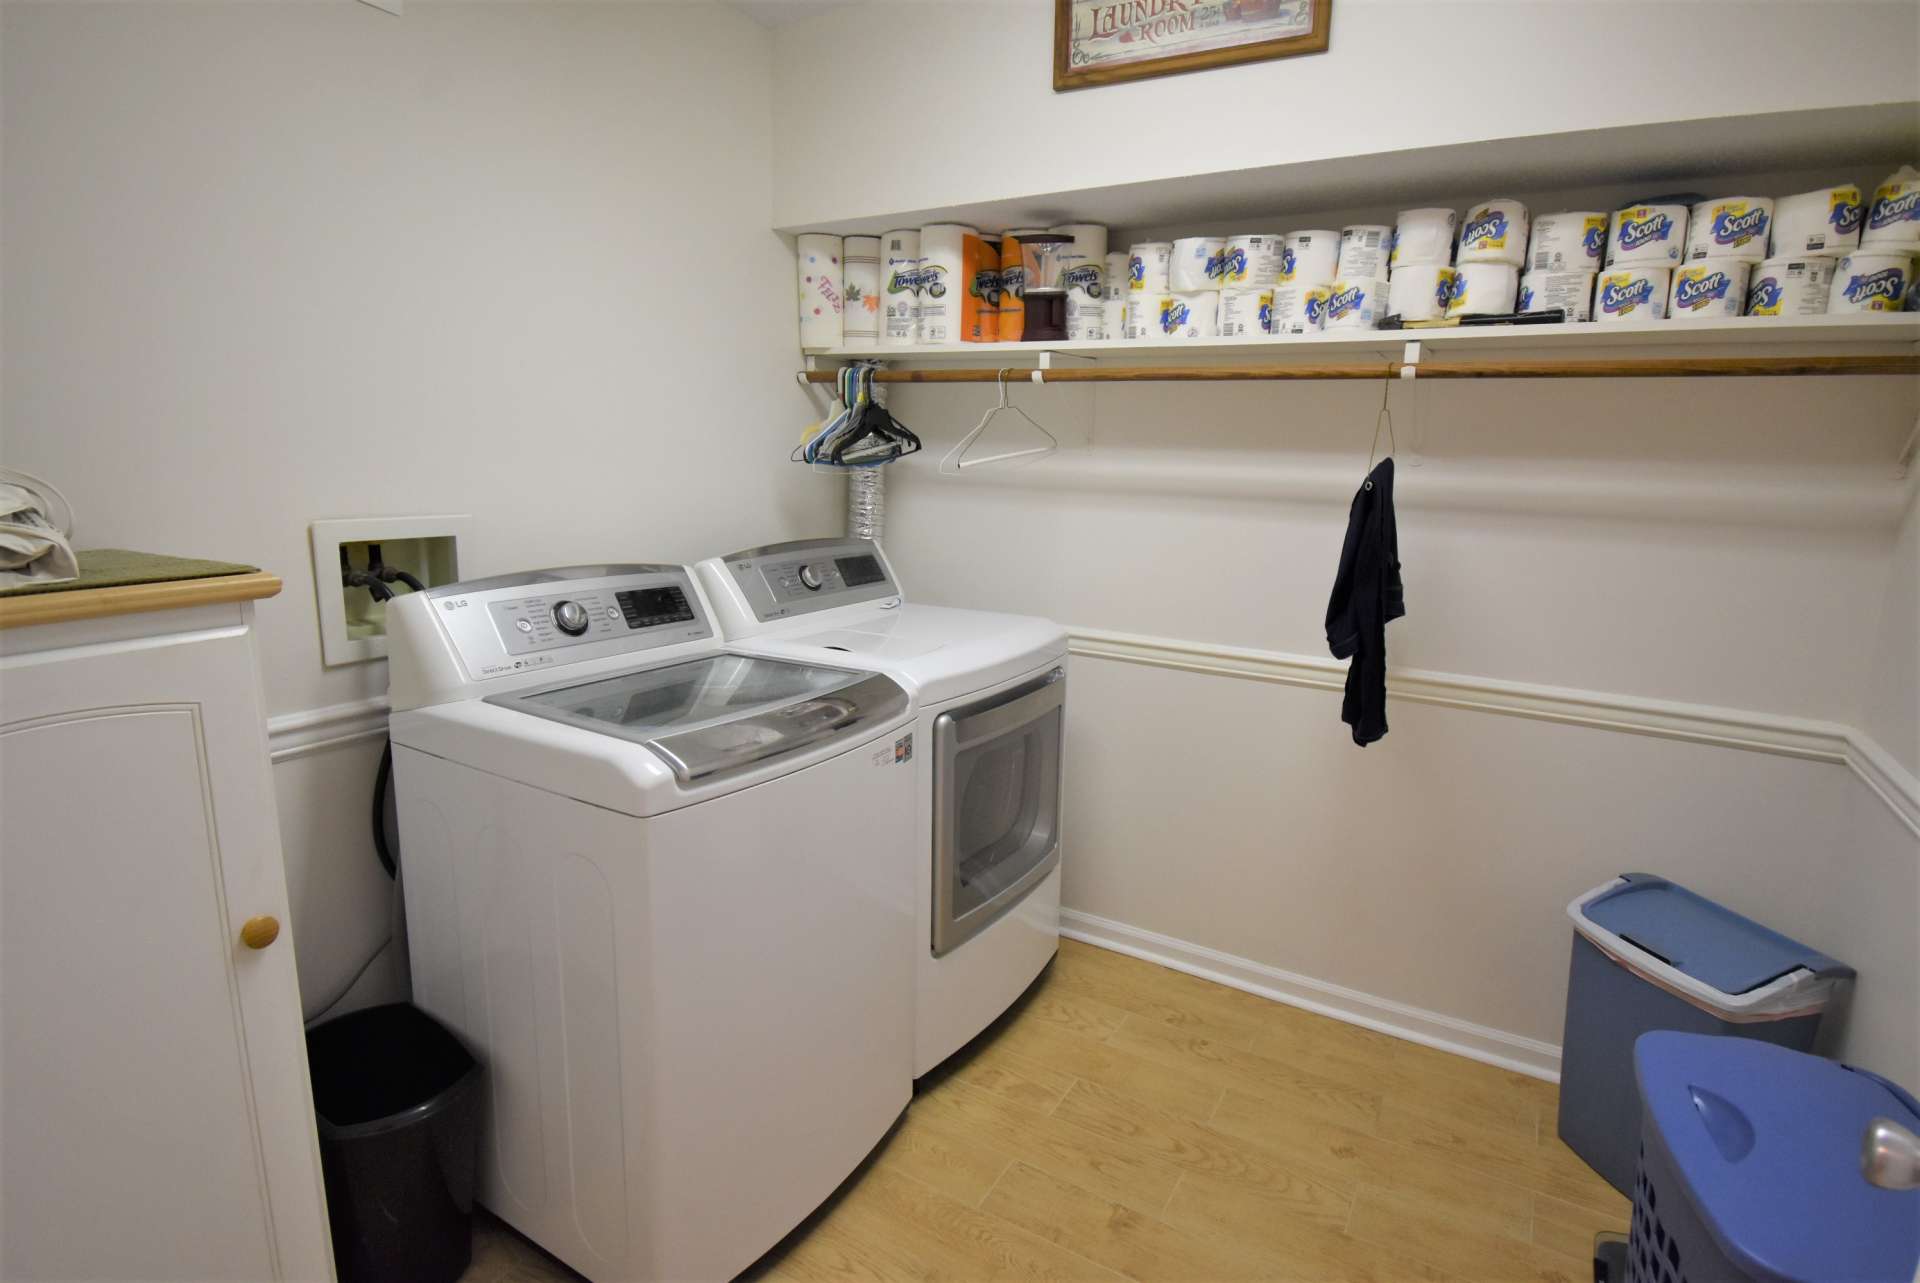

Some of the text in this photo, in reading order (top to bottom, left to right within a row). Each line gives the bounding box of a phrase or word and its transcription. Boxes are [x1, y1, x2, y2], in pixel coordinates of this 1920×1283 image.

[1140, 10, 1195, 44] ROOM
[1463, 219, 1499, 246] Scott
[1624, 213, 1665, 243] Scott
[1719, 209, 1763, 236] Scott
[1330, 287, 1359, 311] Scott
[1607, 279, 1645, 305] Scott
[1681, 272, 1723, 300] Scott
[1852, 276, 1898, 304] Scott
[456, 599, 468, 608] LG
